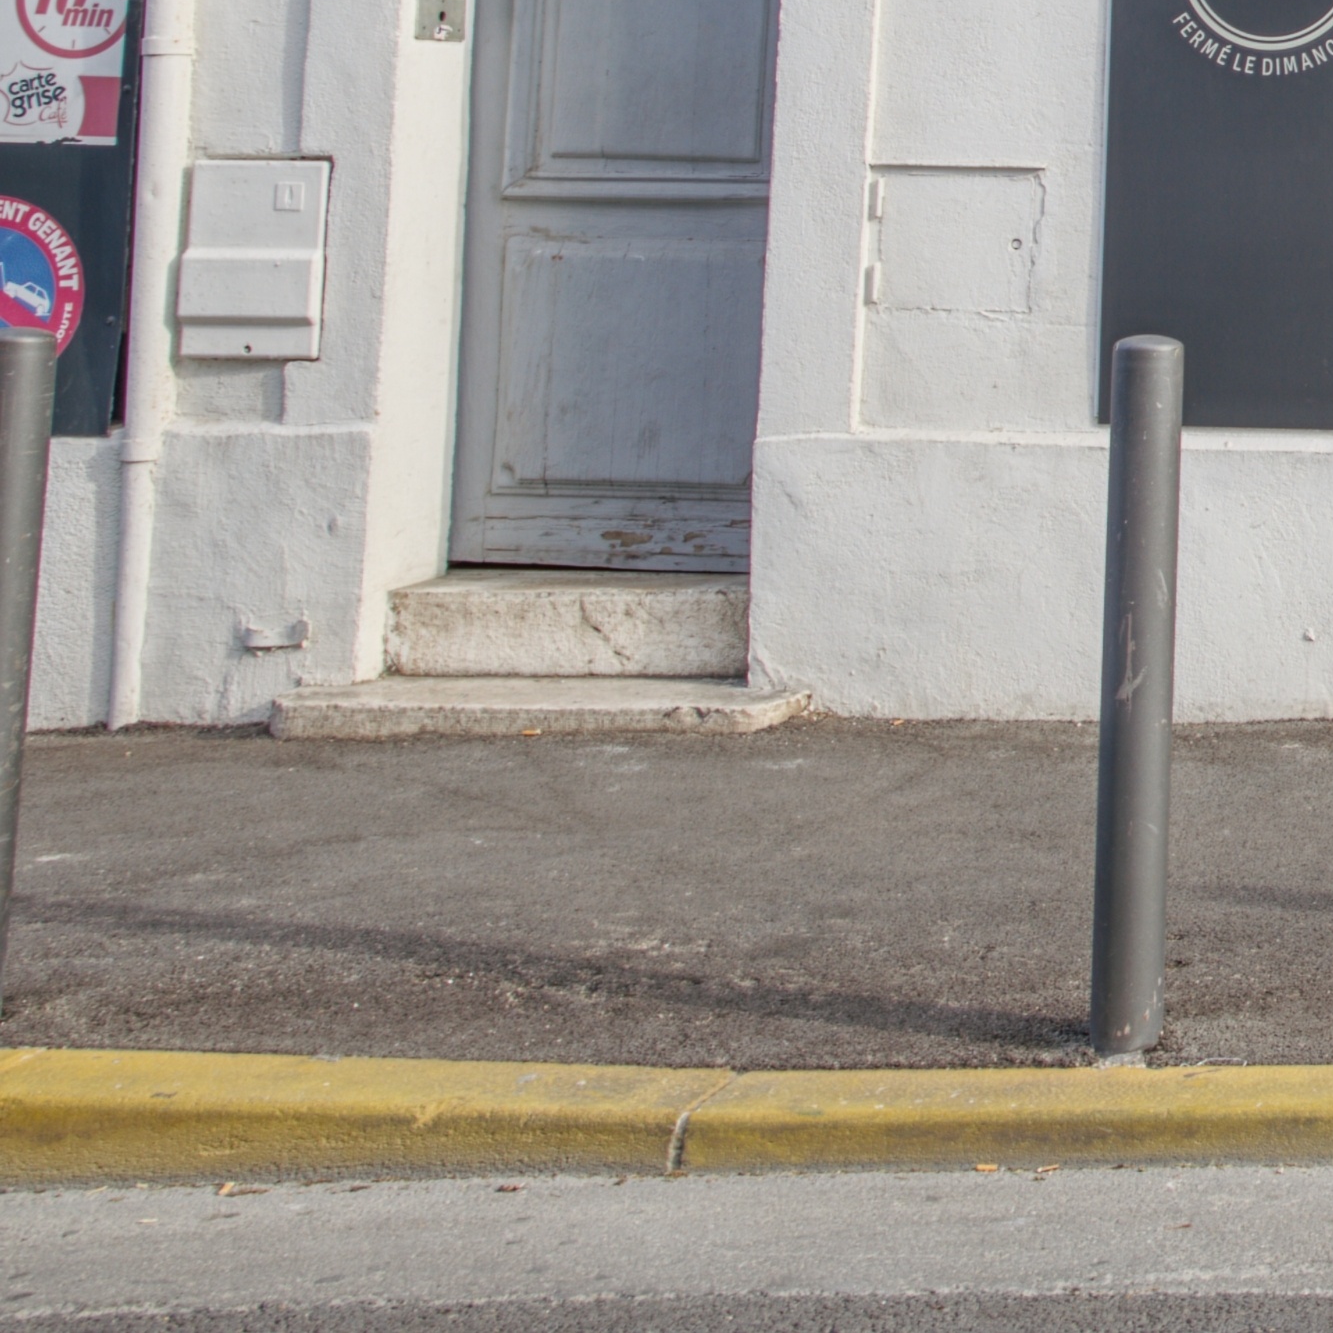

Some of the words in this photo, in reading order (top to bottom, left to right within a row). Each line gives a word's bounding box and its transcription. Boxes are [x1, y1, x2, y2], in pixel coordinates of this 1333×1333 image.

[62, 3, 114, 27] min
[1172, 12, 1233, 66] FERMÉ
[1233, 52, 1256, 75] LE
[8, 72, 57, 95] carte
[11, 85, 66, 118] grise
[28, 212, 79, 291] GENANT
[56, 302, 73, 343] OUTE
